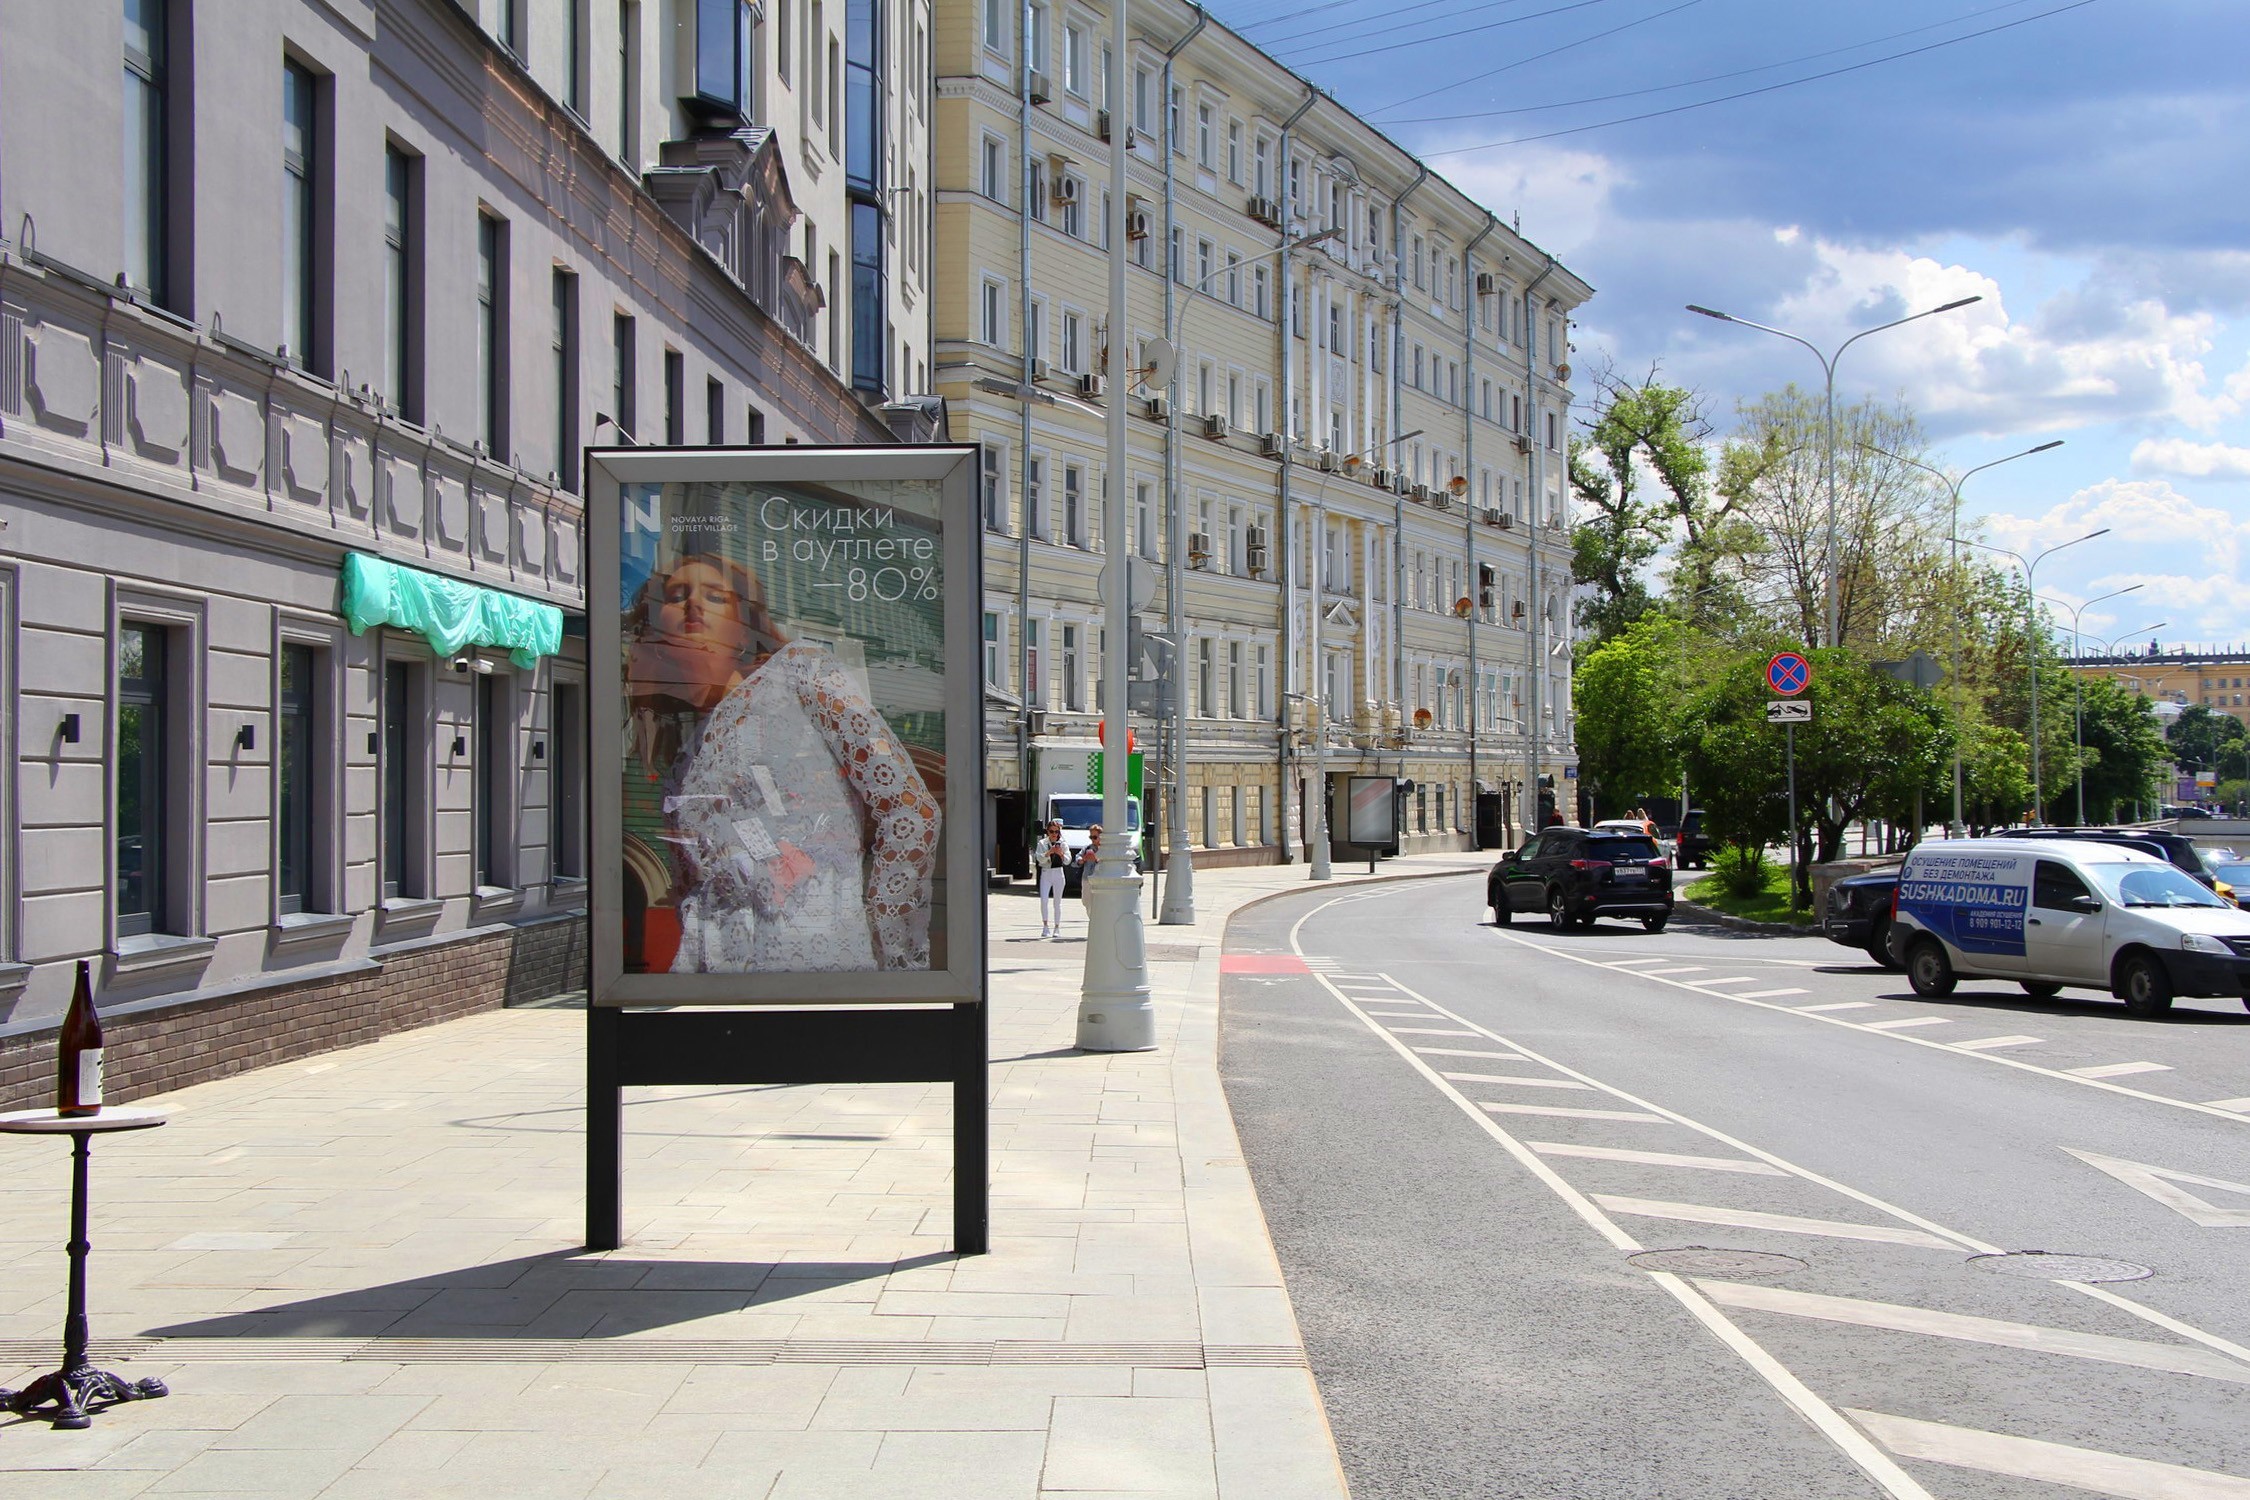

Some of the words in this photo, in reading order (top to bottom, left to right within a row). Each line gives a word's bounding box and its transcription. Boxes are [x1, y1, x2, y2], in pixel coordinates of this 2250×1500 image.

[760, 496, 894, 535] Скидки
[704, 524, 738, 532] VILLAGE
[763, 540, 779, 562] в
[793, 538, 934, 571] аутлете
[1911, 857, 1958, 868] ОСУШЕНИЕ
[1958, 858, 2017, 869] ПОМЕЩЕНИЙ
[1923, 868, 1939, 878] БЕЗ
[1940, 869, 1995, 881] ДЕМОНТАЖА
[1899, 883, 2025, 906] SUSHKADOMA.RU
[1970, 917, 1975, 928] 8
[1976, 918, 1988, 928] 909
[1990, 918, 2023, 930] 901-12-12
